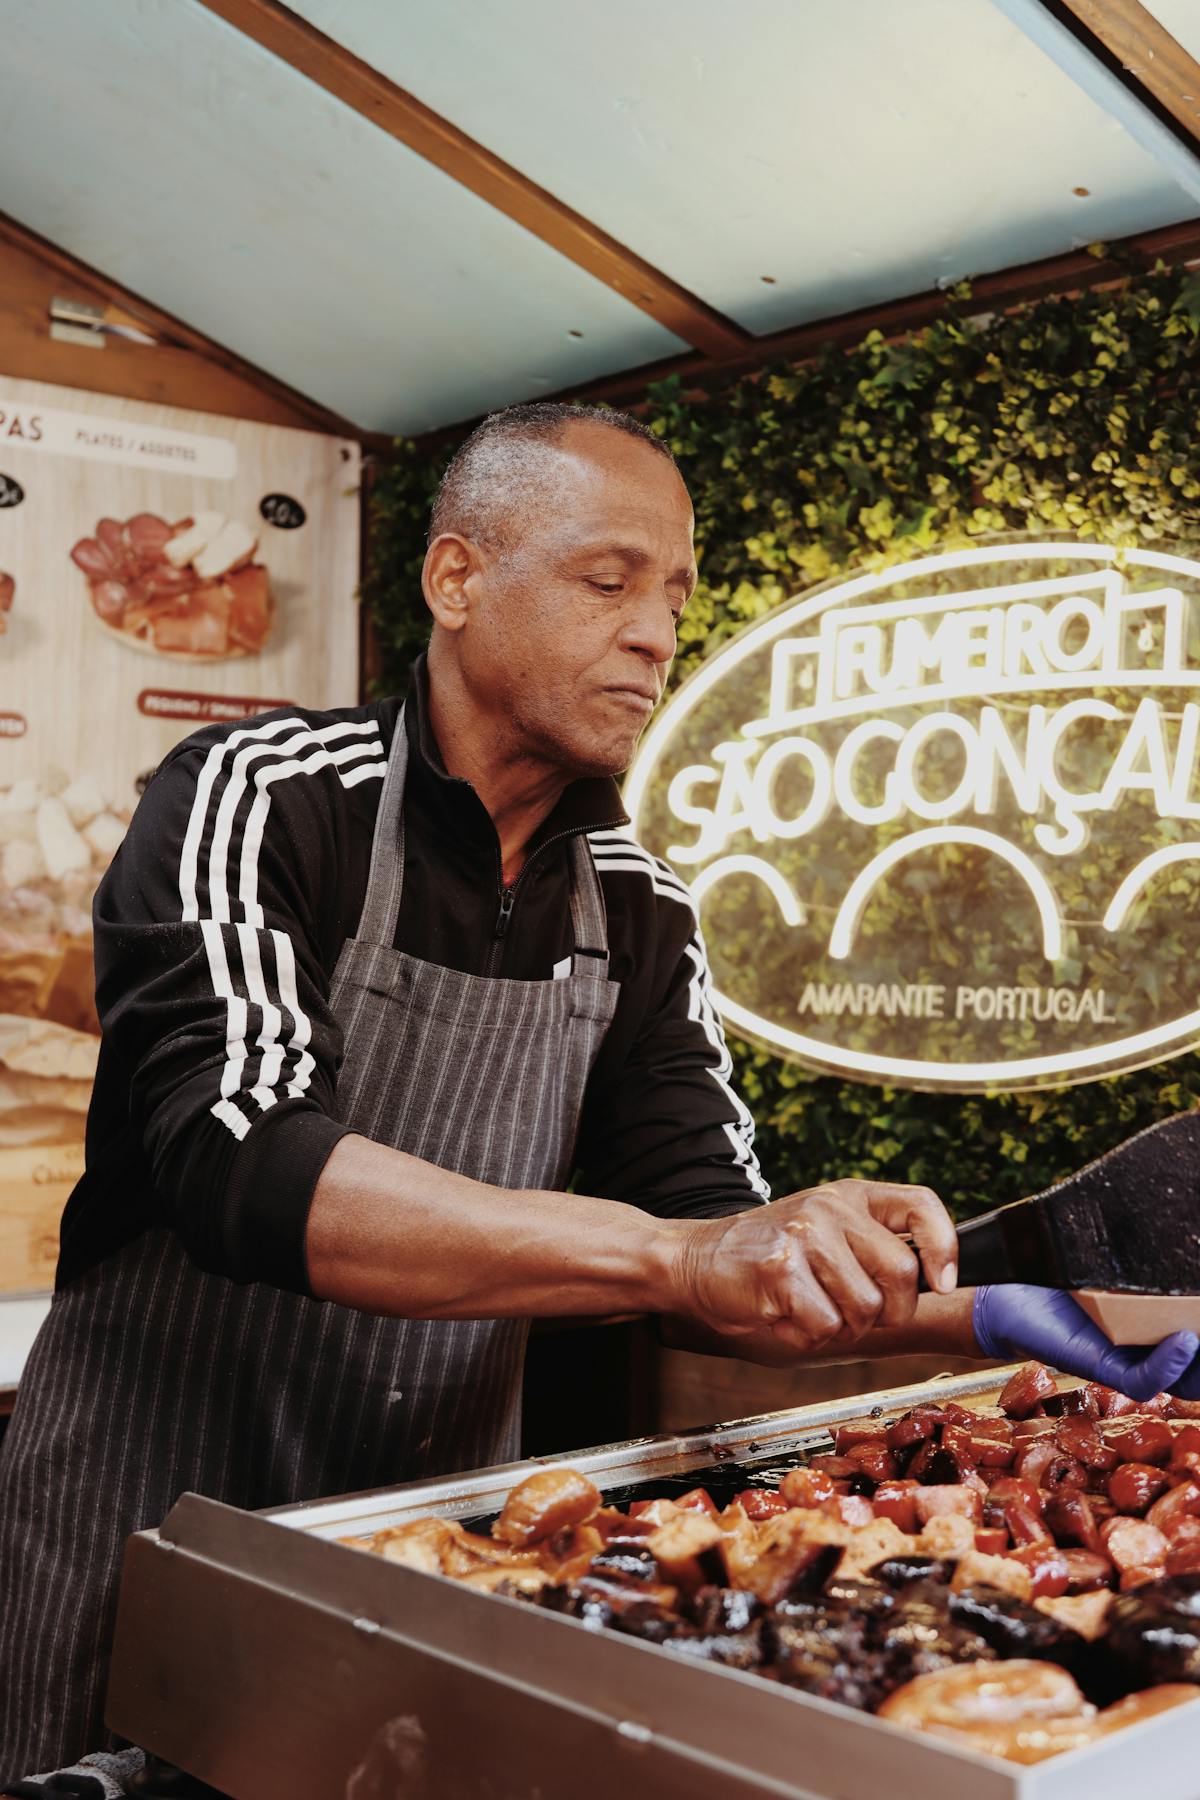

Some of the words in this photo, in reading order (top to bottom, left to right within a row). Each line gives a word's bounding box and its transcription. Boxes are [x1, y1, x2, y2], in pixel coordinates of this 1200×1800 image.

[834, 596, 1104, 699] FUMEIRO
[798, 982, 946, 1018] AMARANTE
[955, 985, 1116, 1024] PORTUGAL
